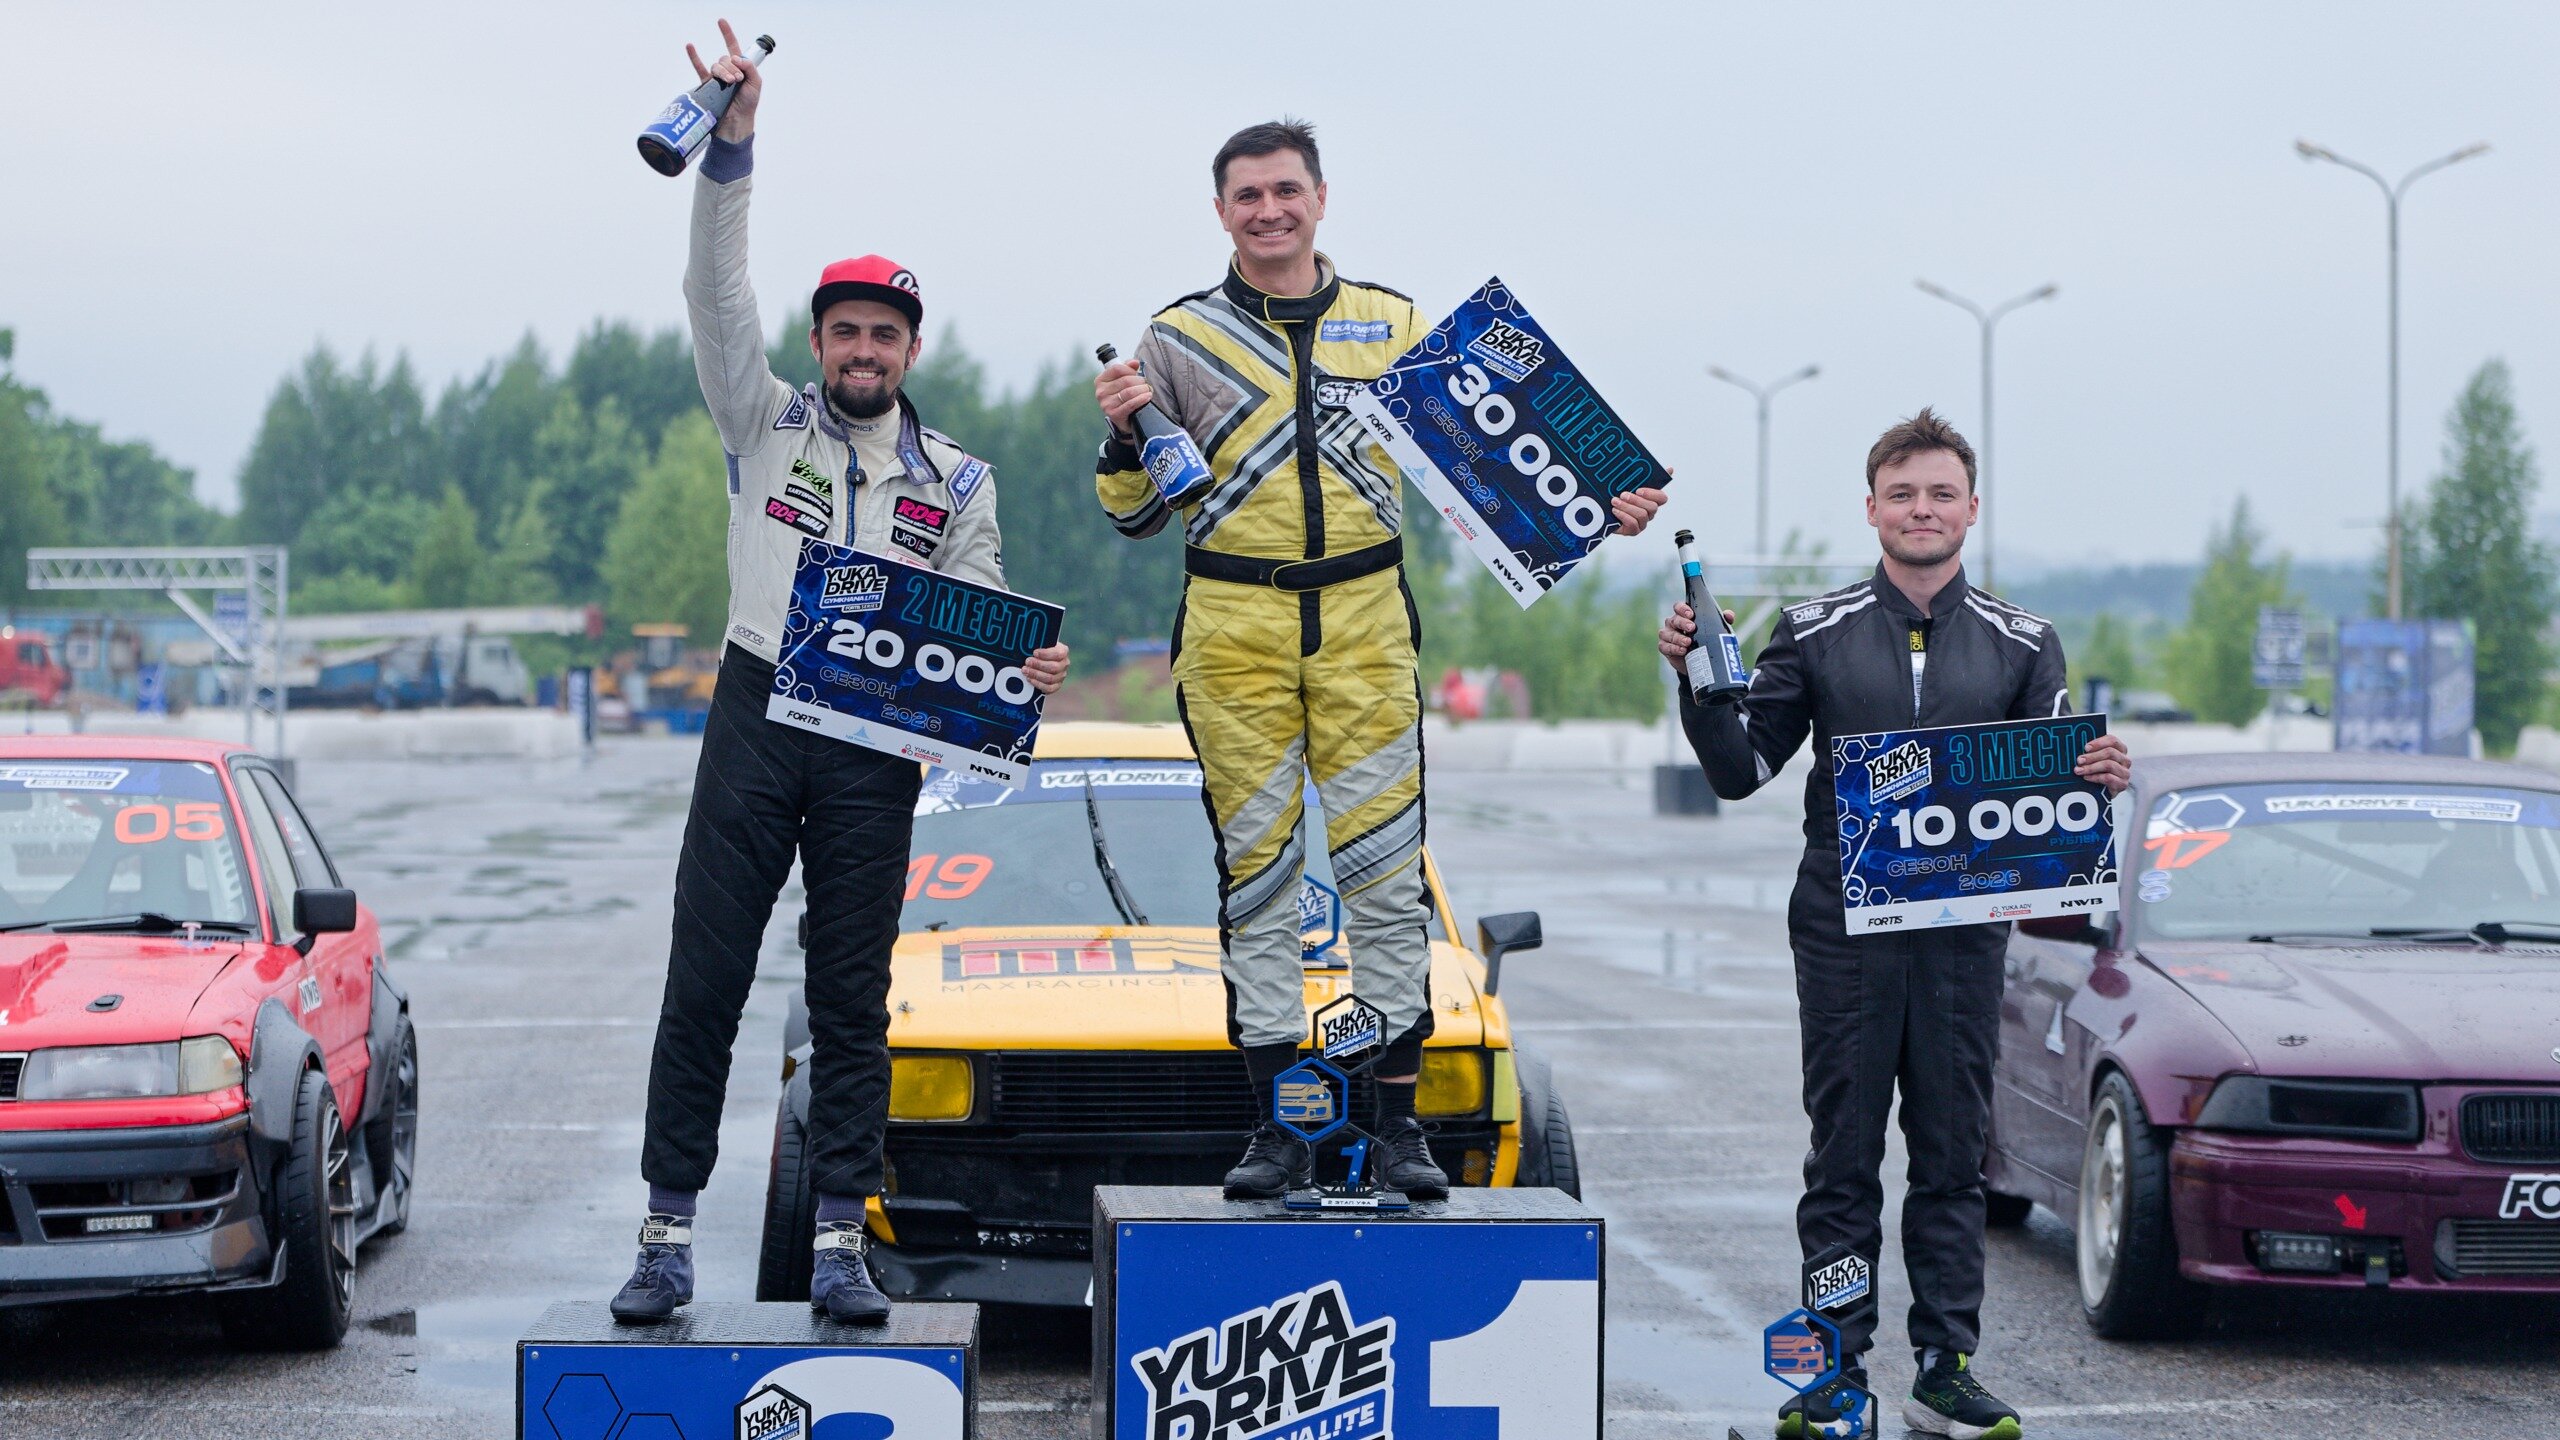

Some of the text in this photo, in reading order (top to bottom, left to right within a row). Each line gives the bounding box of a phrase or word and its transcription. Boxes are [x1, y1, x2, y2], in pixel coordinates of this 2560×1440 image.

[672, 110, 697, 135] YUKA
[1323, 323, 1350, 333] YUKA
[1352, 324, 1387, 334] DRIVE
[1489, 320, 1541, 355] YUKA
[1473, 343, 1527, 374] GYMKHANA LITE
[1479, 332, 1543, 369] DRIVE
[1366, 413, 1395, 442] FORTIS
[1423, 396, 1484, 463] СЕЗОН
[1532, 371, 1652, 498] 1 МЕСТО
[1152, 448, 1172, 474] YUKA
[1158, 449, 1180, 481] DRIVE
[1178, 441, 1200, 468] YUKA
[1448, 363, 1606, 538] 30 000
[956, 460, 979, 493] sparco
[1452, 462, 1501, 514] 2026
[767, 501, 800, 523] RDS
[897, 500, 946, 526] RDS
[1456, 512, 1479, 538] YUKA ADV
[1538, 509, 1576, 551] РУБЛЕЙ
[824, 578, 886, 596] DRIVE
[826, 566, 877, 583] YUKA
[1493, 558, 1524, 593] NWB
[824, 596, 864, 604] GYMKHANA
[1793, 607, 1824, 621] OMP
[901, 575, 1048, 657] 2 МЕСТО
[2011, 619, 2042, 634] OMP
[733, 625, 765, 644] sparco
[1912, 632, 1921, 651] OMP
[827, 618, 1035, 706] 20 000
[1726, 643, 1739, 673] YUKA
[820, 666, 897, 700] СЕЗОН
[786, 710, 821, 726] FORTIS
[881, 703, 942, 732] 2026
[977, 700, 1026, 722] РУБЛЕЙ
[914, 746, 944, 759] YUKA ADV
[1868, 743, 1919, 776] YUKA
[1949, 734, 1974, 785] 3
[969, 763, 1011, 781] NWB
[1045, 772, 1193, 786] YUKA DRIVE
[1873, 750, 1929, 790] DRIVE
[1873, 769, 1927, 799] GYMKHANA LITE
[2271, 800, 2333, 810] YUKA
[2334, 799, 2411, 808] DRIVE
[114, 803, 225, 844] 05
[1892, 791, 2099, 848] 10 000
[2050, 832, 2100, 847] РУБЛЕЙ
[2143, 831, 2231, 870] 17
[902, 854, 994, 900] 19
[1887, 854, 1968, 877] СЕЗОН
[1959, 870, 2021, 891] 2026
[2060, 898, 2103, 908] NWB
[1868, 915, 1903, 927] FORTIS
[941, 974, 1220, 993] MAXRACINGEX
[1322, 1006, 1368, 1035] YUKA
[1326, 1014, 1376, 1047] DRIVE
[1326, 1030, 1375, 1054] GYMKHANA LITE
[1340, 1139, 1369, 1184] 1
[646, 1230, 668, 1239] OMP
[839, 1236, 859, 1247] OMP
[1812, 1257, 1858, 1287] YUKA
[1817, 1264, 1867, 1299] DRIVE
[1817, 1279, 1866, 1306] GYMKHANA LITE
[1140, 1288, 1350, 1411] YUKA
[1155, 1325, 1388, 1440] DRIVE
[743, 1399, 790, 1429] YUKA
[748, 1406, 799, 1440] DRIVE
[784, 1422, 798, 1435] LITE
[1319, 1402, 1375, 1440] LITE
[1824, 1389, 1868, 1440] 3
